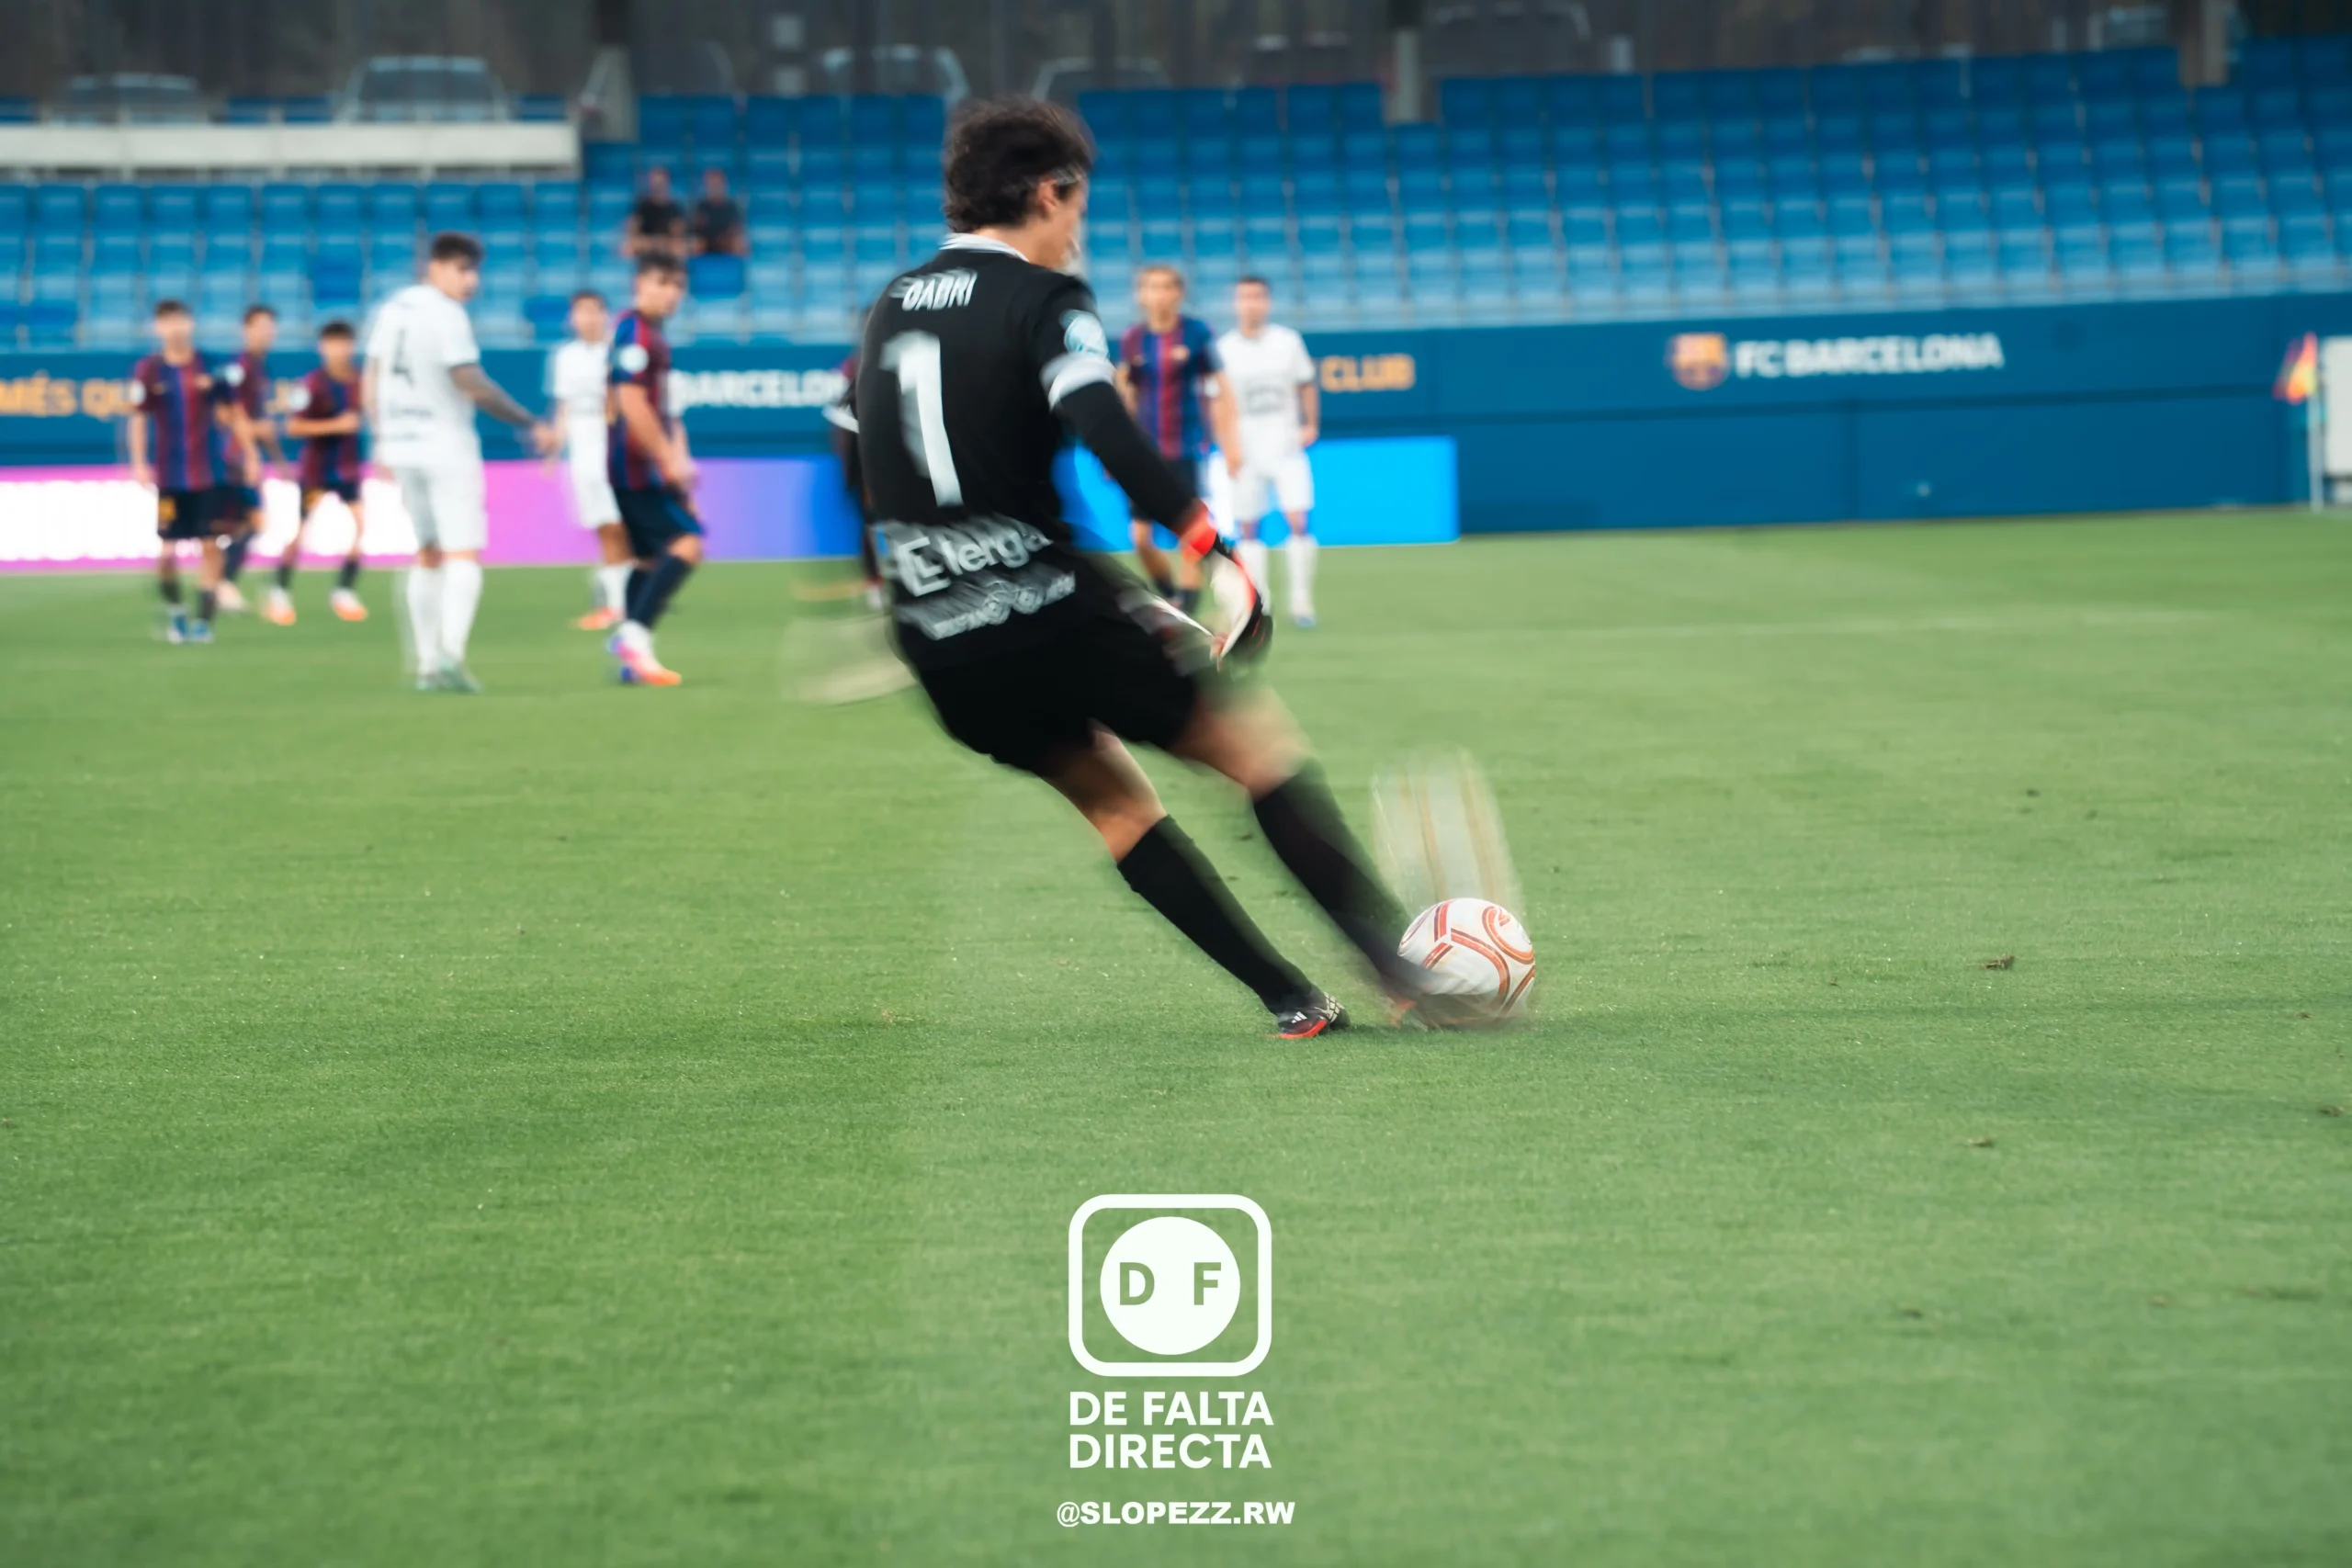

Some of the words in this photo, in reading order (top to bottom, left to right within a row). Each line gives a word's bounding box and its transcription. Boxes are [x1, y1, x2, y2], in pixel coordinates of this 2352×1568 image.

[1320, 353, 1416, 391] CLUB
[1735, 340, 1784, 378] FC
[1784, 333, 2005, 378] BARCELONA
[665, 368, 849, 408] BARCELON
[881, 330, 963, 507] 1
